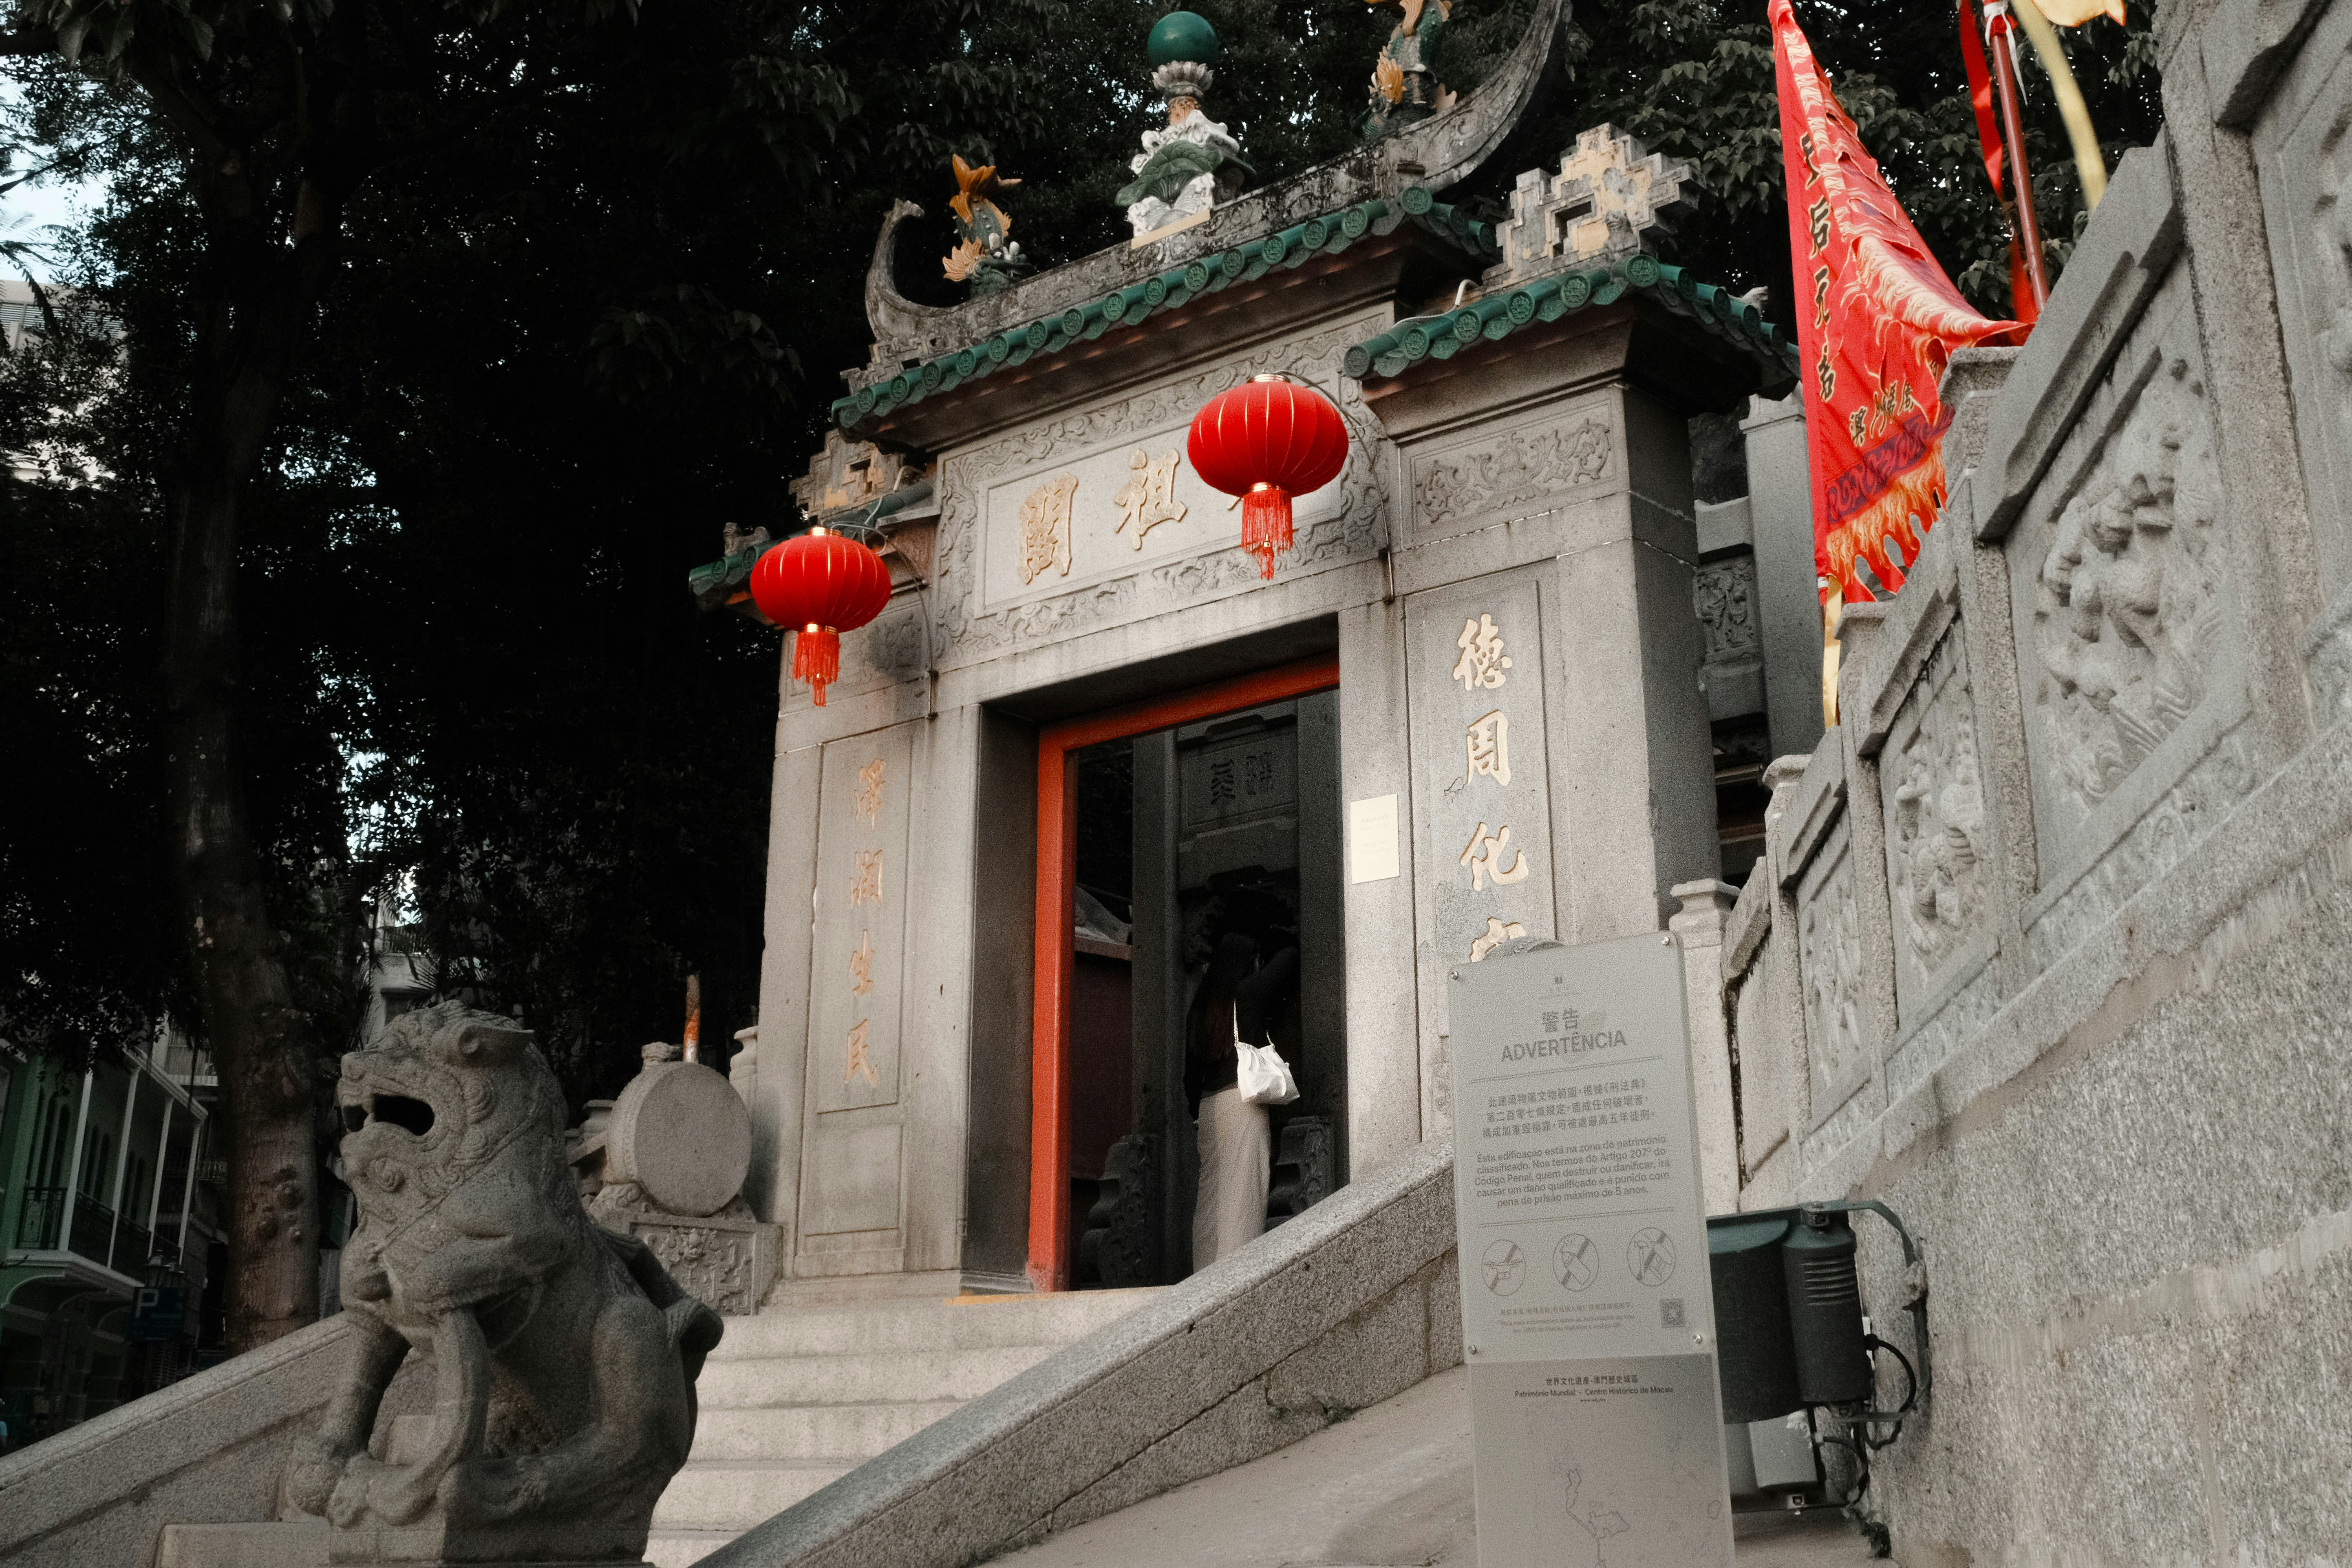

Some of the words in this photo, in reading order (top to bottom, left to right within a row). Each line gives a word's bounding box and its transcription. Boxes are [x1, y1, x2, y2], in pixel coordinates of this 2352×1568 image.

[1018, 448, 1243, 586] 祖閣
[1542, 1008, 1580, 1032] 警告
[1501, 1030, 1627, 1062] ADVERTÊNCIA
[135, 1288, 159, 1318] P
